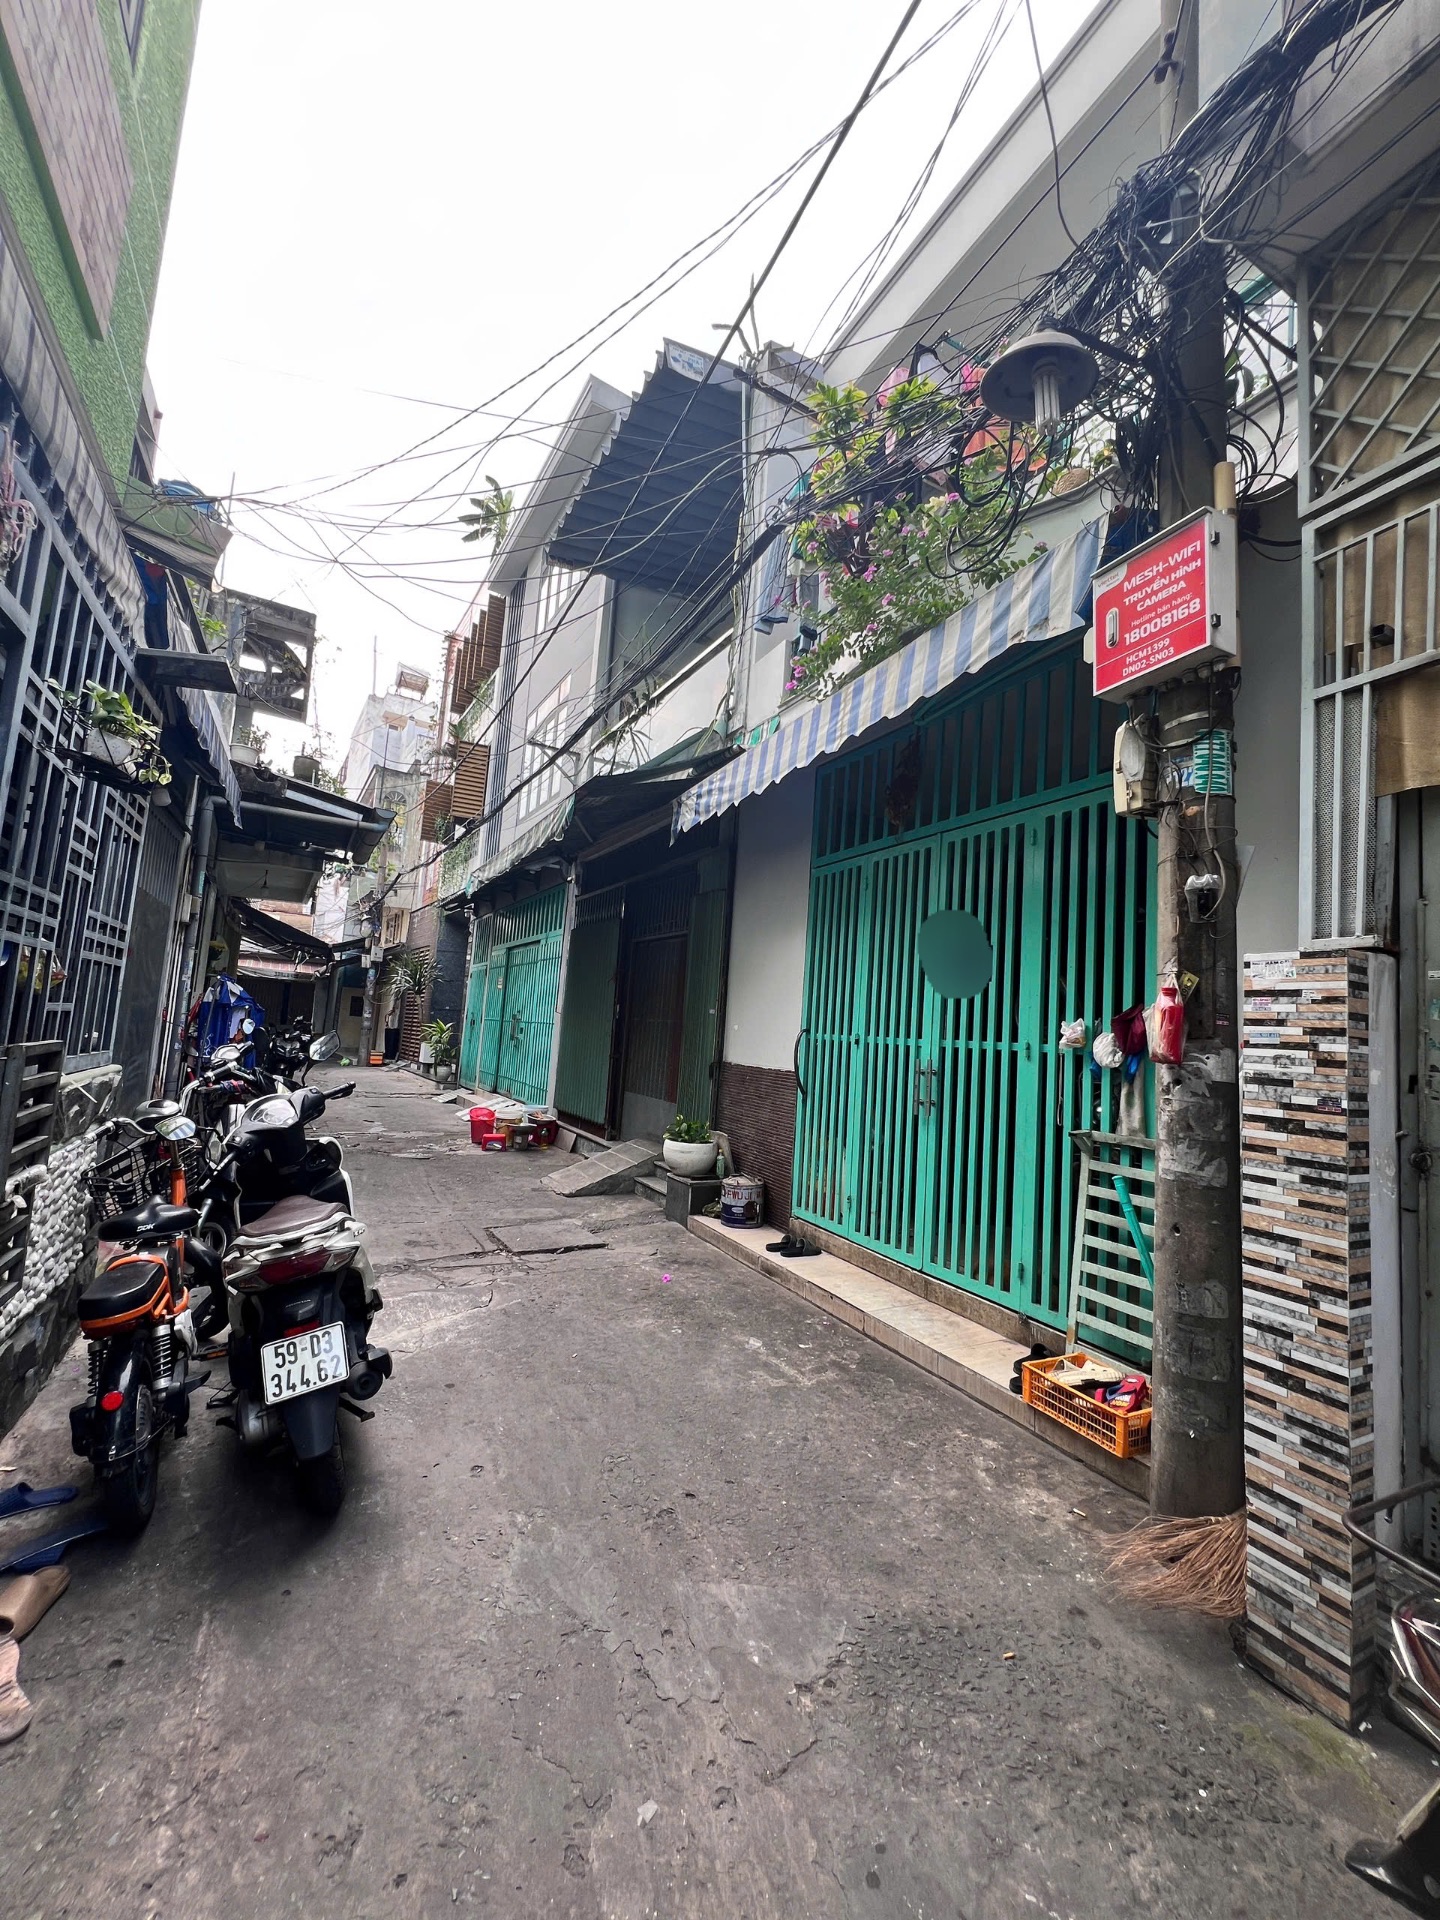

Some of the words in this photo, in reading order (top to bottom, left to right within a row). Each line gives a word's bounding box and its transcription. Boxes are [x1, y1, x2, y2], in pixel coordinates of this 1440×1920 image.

[1123, 540, 1201, 592] MESH-WIFI
[1171, 558, 1202, 581] HÌNH
[1137, 580, 1187, 611] CAMERA
[1124, 598, 1201, 646] 18008168
[1131, 611, 1156, 627] Hotline
[1157, 603, 1170, 615] bán
[1122, 647, 1175, 677] DN02-SN03
[1126, 638, 1170, 665] HCM1399
[273, 1330, 333, 1369] 59-D3
[270, 1354, 342, 1398] 344.62
